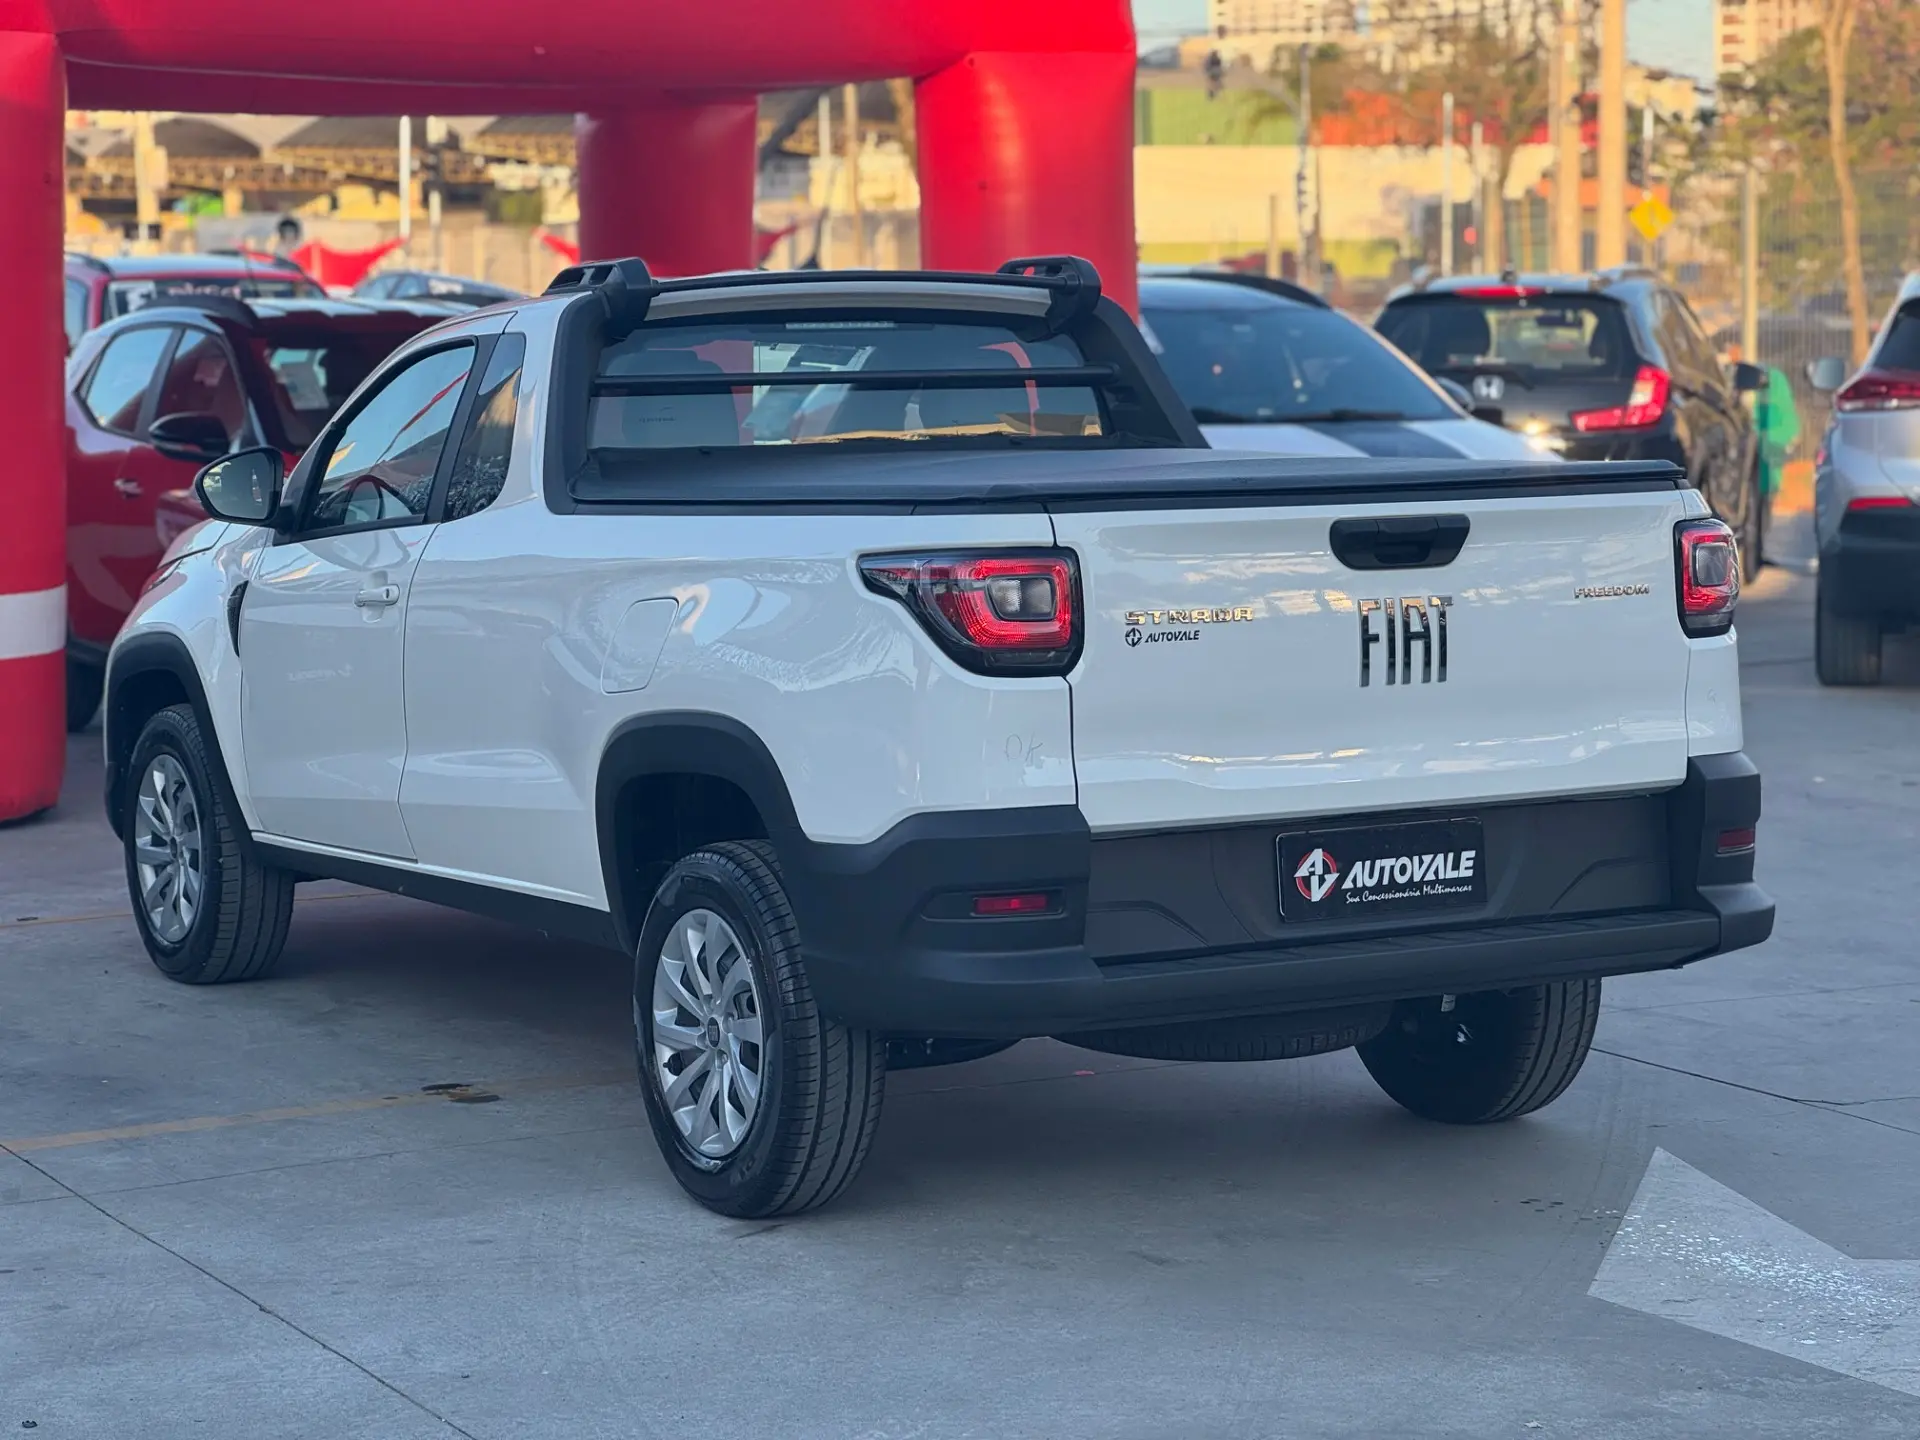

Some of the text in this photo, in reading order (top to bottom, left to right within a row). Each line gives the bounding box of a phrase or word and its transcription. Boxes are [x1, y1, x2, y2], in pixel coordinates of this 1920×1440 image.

[1574, 584, 1650, 599] FREEDOM
[1124, 607, 1255, 626] STRADA
[1144, 629, 1200, 643] AUTOVALE
[1358, 596, 1453, 687] FIAT
[1341, 850, 1477, 889] AUTOVALE
[1346, 883, 1473, 904] Sua Concessionária Multimarcas
